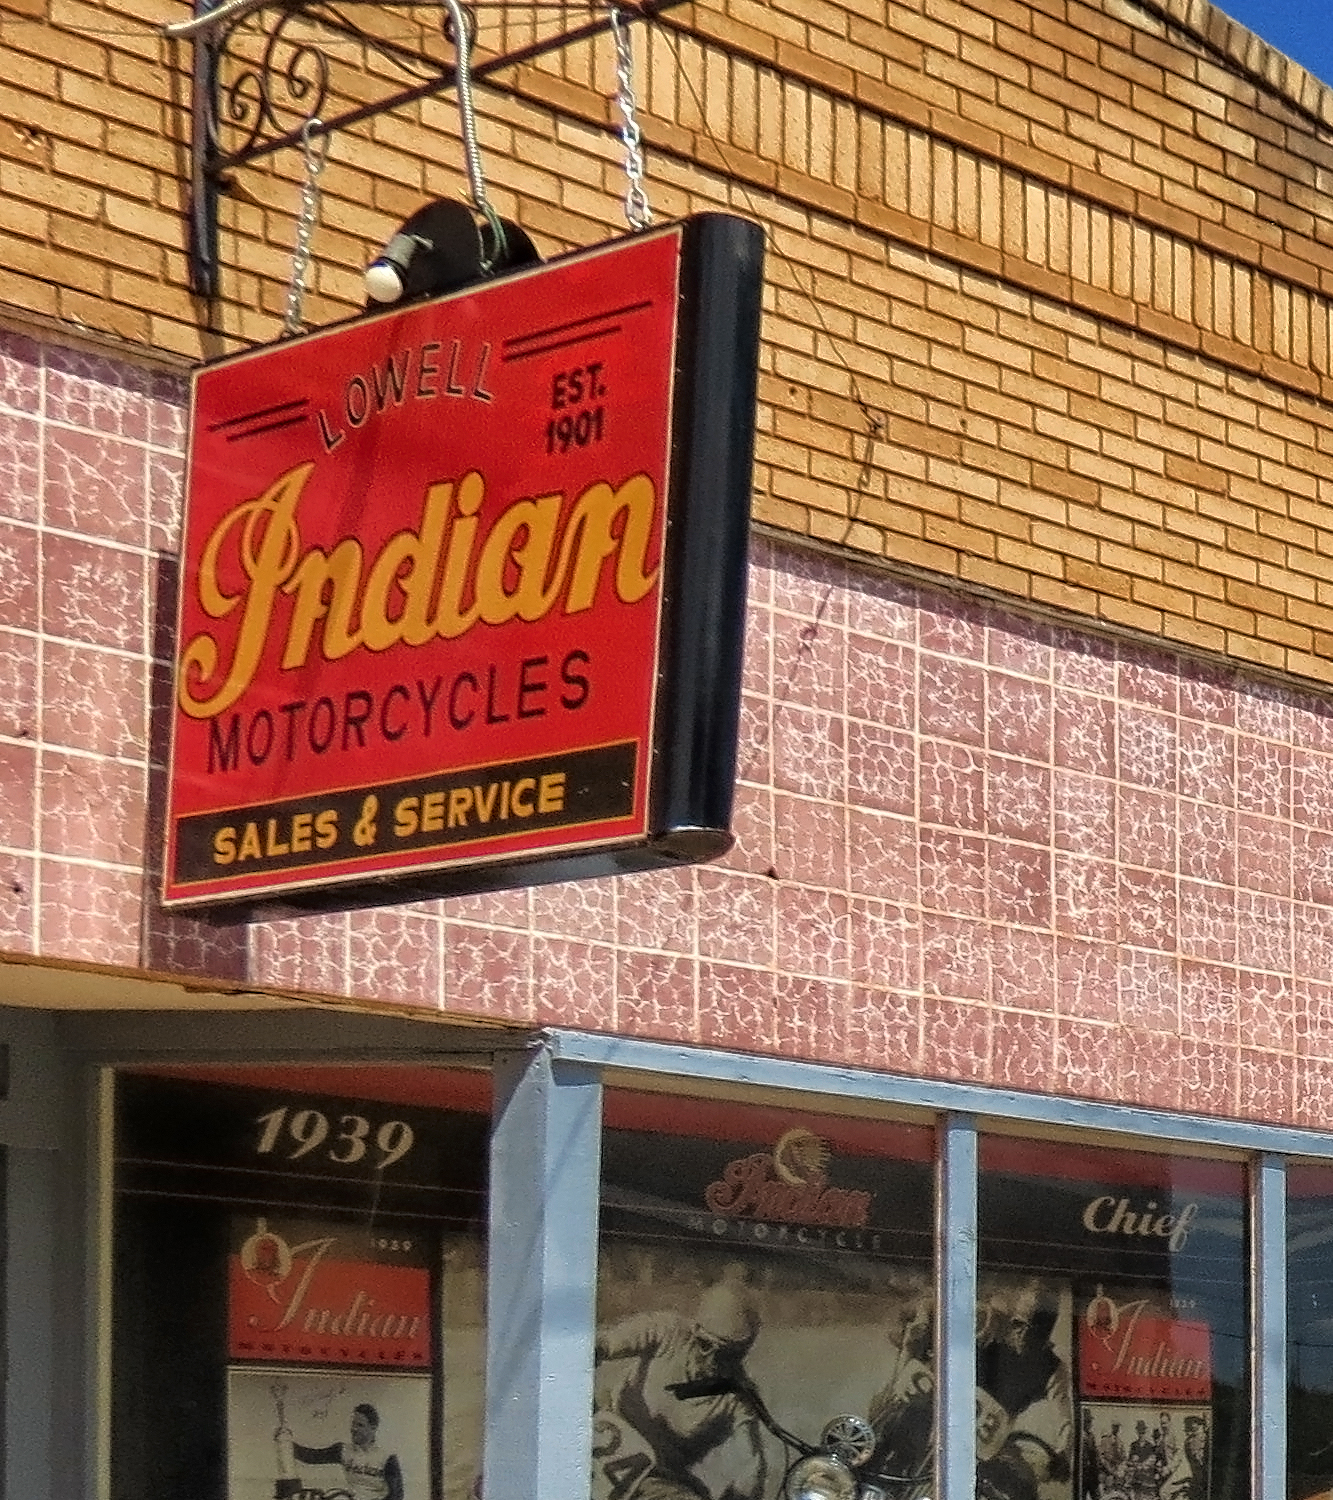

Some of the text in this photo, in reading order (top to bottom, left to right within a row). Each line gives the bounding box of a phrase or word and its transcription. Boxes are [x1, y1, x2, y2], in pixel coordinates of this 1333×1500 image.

[317, 338, 494, 455] LOWELL
[551, 362, 606, 410] EST.
[546, 406, 604, 453] 1901
[178, 461, 657, 719] Indian
[207, 649, 591, 775] MOTORCYCLES
[213, 772, 566, 865] SALES & SERVICE
[256, 1106, 414, 1169] 1939
[1083, 1196, 1198, 1252] Chief
